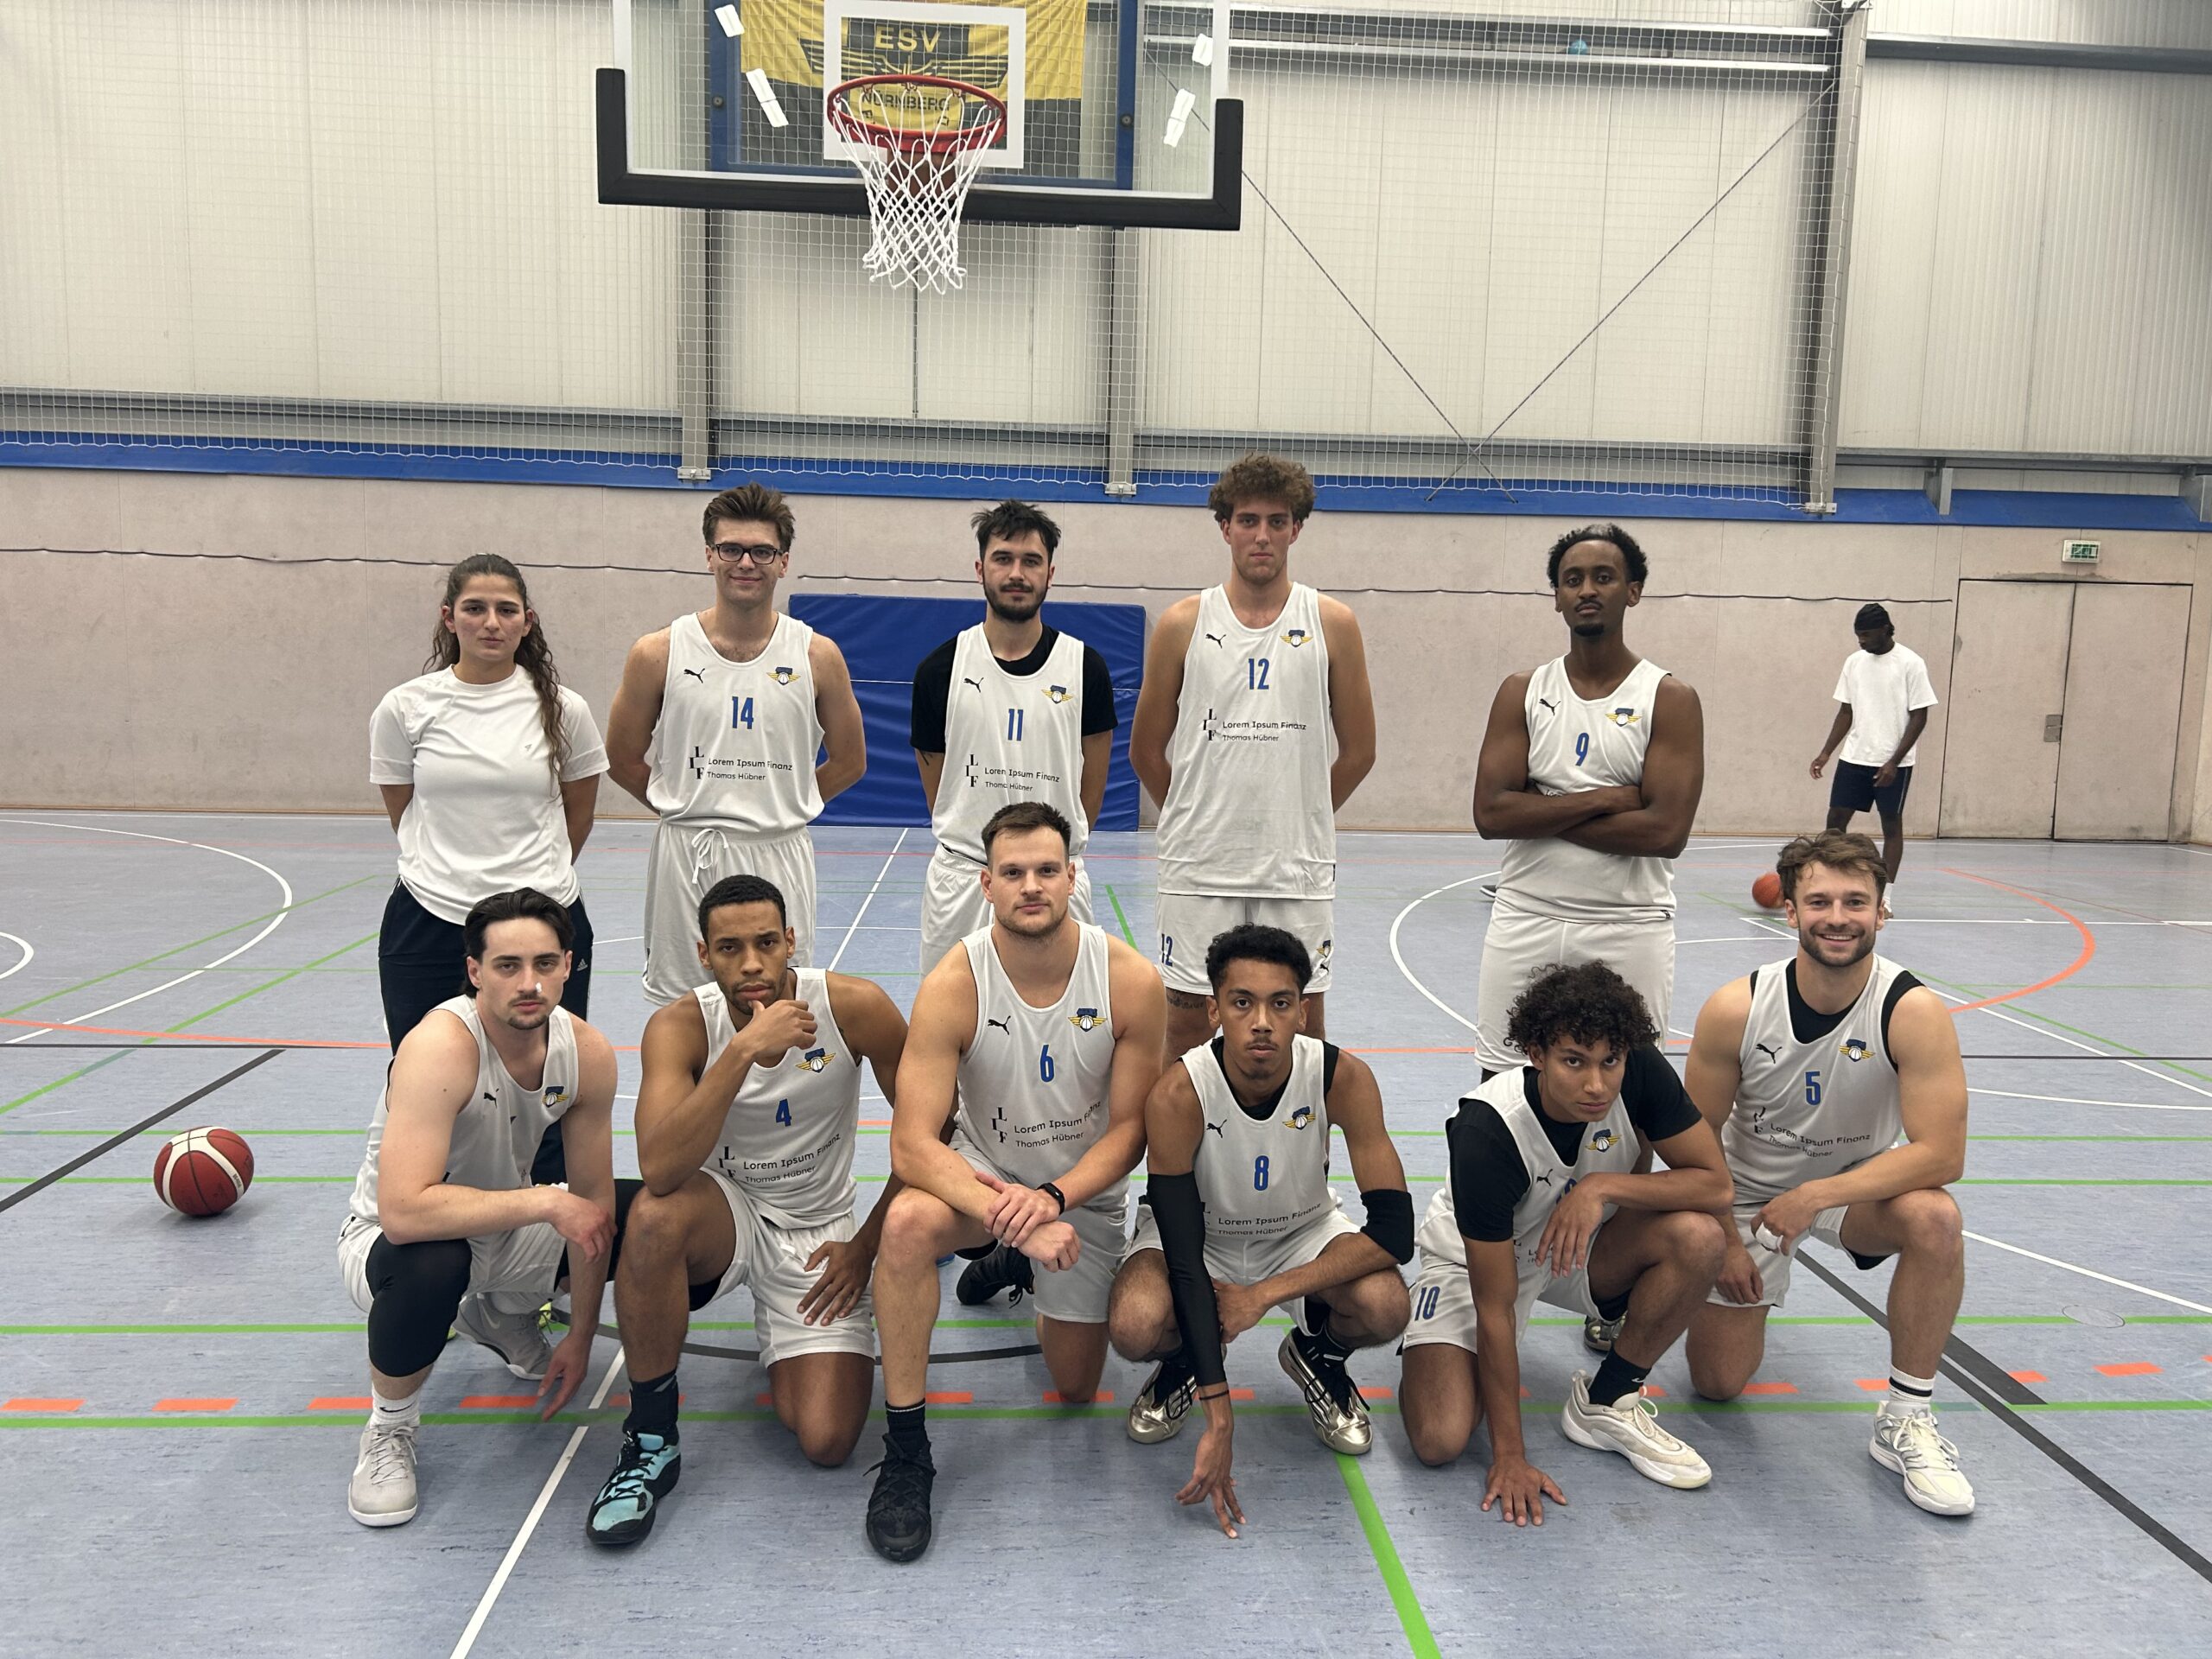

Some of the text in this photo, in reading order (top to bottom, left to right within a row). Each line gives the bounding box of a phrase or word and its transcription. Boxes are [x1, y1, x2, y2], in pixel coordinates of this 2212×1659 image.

[874, 26, 942, 53] ESV
[1248, 658, 1270, 690] 12
[732, 696, 754, 729] 14
[1007, 709, 1024, 741] 11
[1223, 721, 1249, 729] Lorem
[1252, 721, 1279, 732] Ipsum
[1575, 733, 1589, 766] 9
[707, 771, 766, 781] Thomas Hübner
[708, 758, 793, 772] Lorem Ipsum Finanz
[1008, 769, 1034, 779] Ipsum
[1036, 772, 1060, 783] Finanz
[1161, 933, 1173, 967] 12
[1039, 1044, 1054, 1083] 6
[1805, 1071, 1821, 1105] 5
[776, 1098, 792, 1127] 4
[1014, 1123, 1046, 1134] Lorem
[1049, 1118, 1083, 1130] Ipsum
[1015, 1131, 1084, 1148] Thomas Hübner
[1770, 1123, 1871, 1147] Lorem Ipsum Finanz
[743, 1134, 841, 1171] Lorem Ipsum Finanz
[745, 1165, 816, 1184] Thomas Hübner
[1254, 1155, 1269, 1191] 8
[1218, 1217, 1252, 1226] Lorem
[1255, 1215, 1289, 1226] Ipsum
[1292, 1203, 1322, 1220] Finanz
[1255, 1225, 1288, 1235] Hübner
[1414, 1286, 1440, 1321] 10
